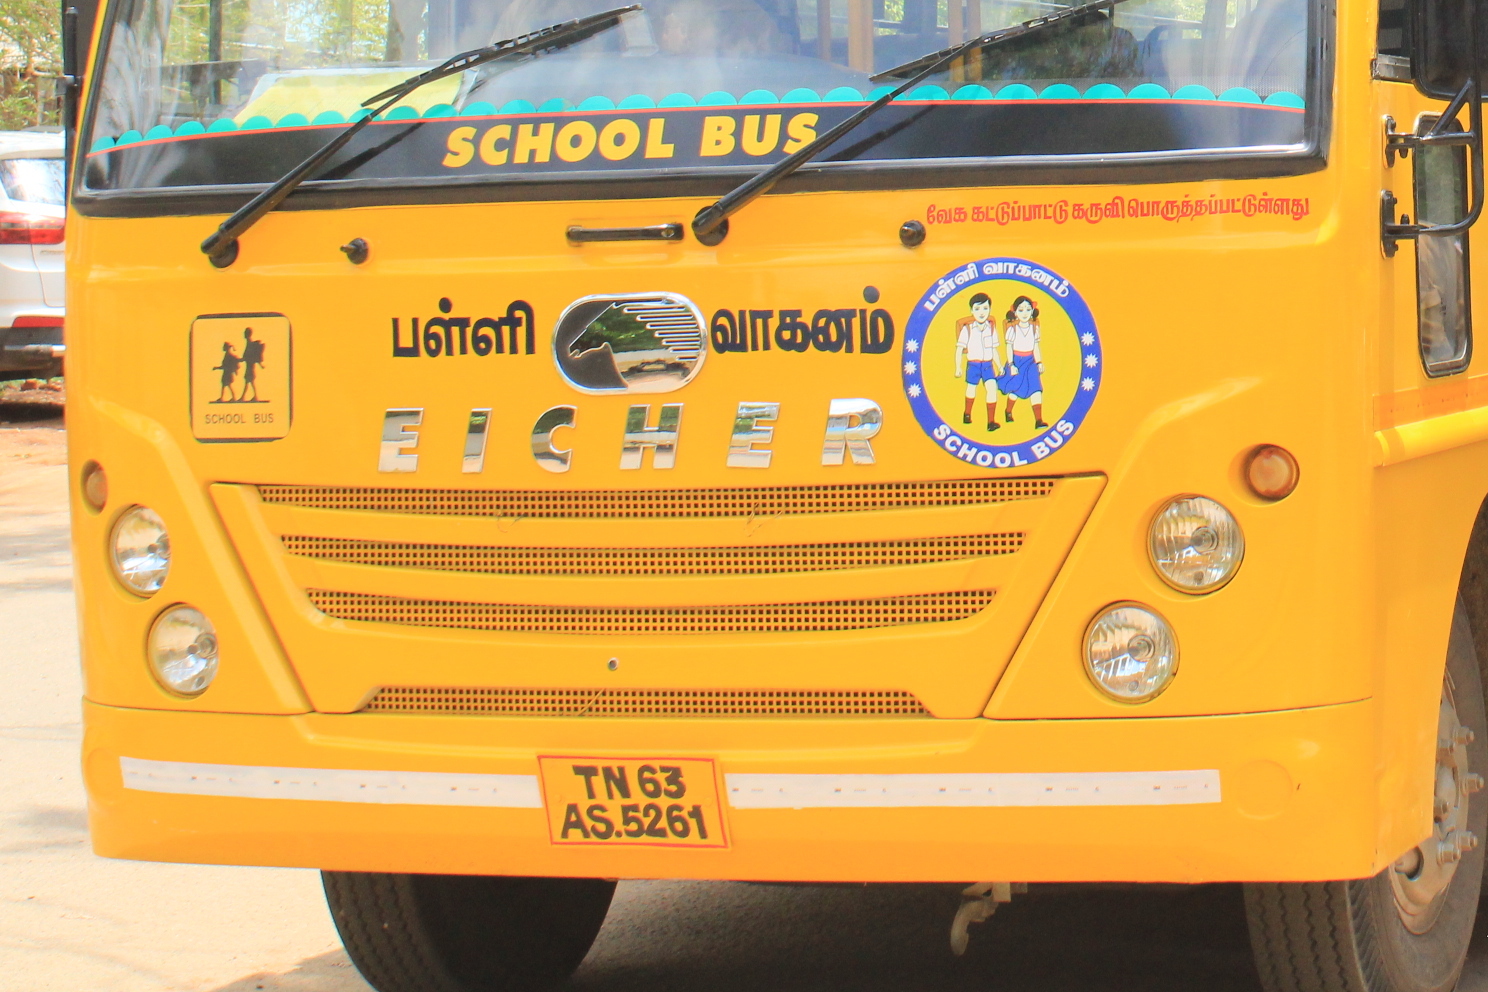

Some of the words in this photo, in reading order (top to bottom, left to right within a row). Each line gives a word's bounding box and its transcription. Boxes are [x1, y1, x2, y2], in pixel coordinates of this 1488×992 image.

[441, 117, 675, 168] SCHOOL
[699, 112, 819, 157] BUS
[924, 263, 979, 312] பள்ளி
[983, 261, 1070, 298] வாகனம்
[392, 297, 536, 358] பள்ளி
[710, 286, 895, 355] வாகனம்
[205, 413, 247, 425] SCHOOL
[254, 413, 274, 424] BUS
[377, 398, 883, 474] EICHER
[933, 423, 1028, 468] SCHOOL
[1031, 419, 1075, 460] BUS
[572, 764, 632, 800] TN
[637, 764, 687, 799] 63
[561, 802, 708, 840] AS.5261
